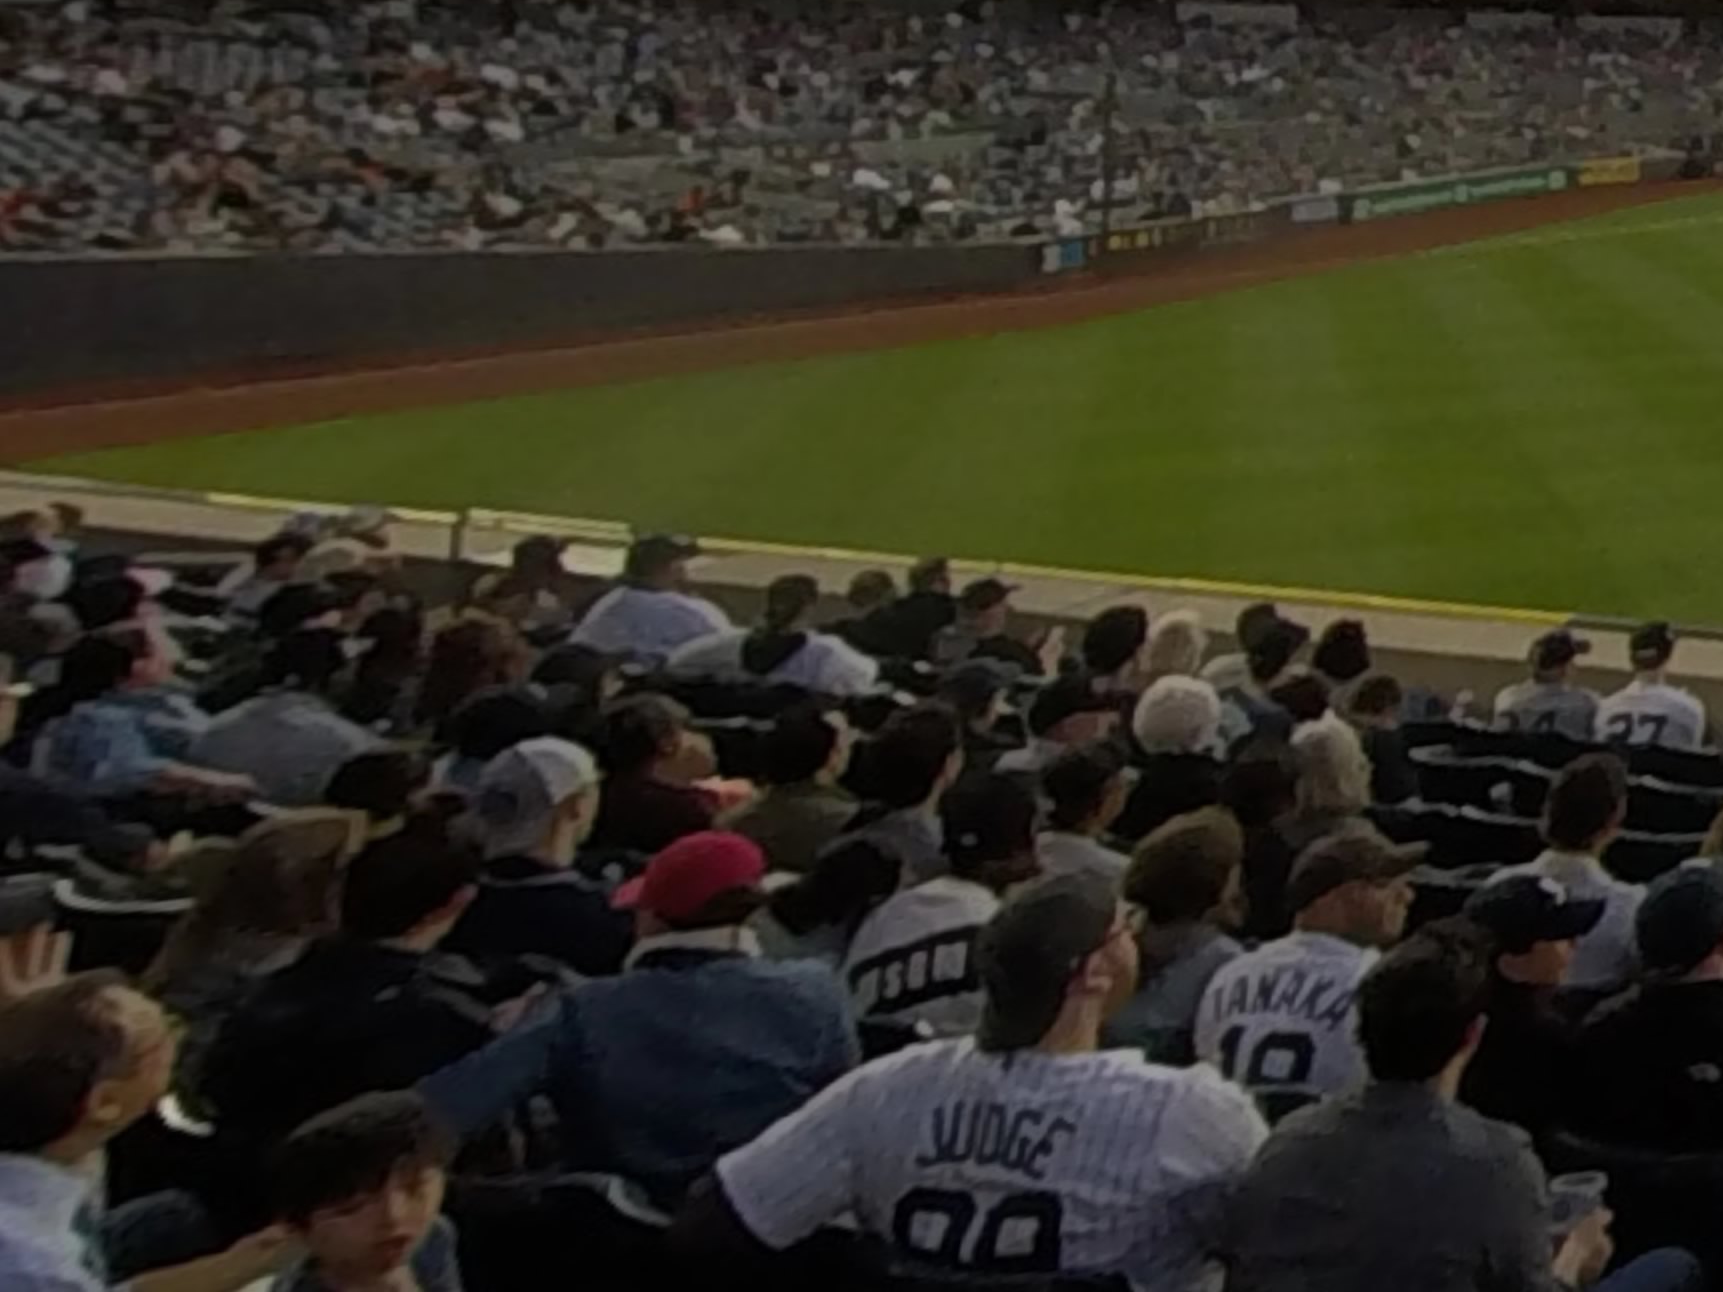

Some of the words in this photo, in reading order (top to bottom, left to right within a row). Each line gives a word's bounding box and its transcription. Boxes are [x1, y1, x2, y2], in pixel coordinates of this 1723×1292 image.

[1604, 713, 1668, 745] 27
[1211, 968, 1357, 1033] TANAKA
[916, 1101, 1076, 1179] JUDGE
